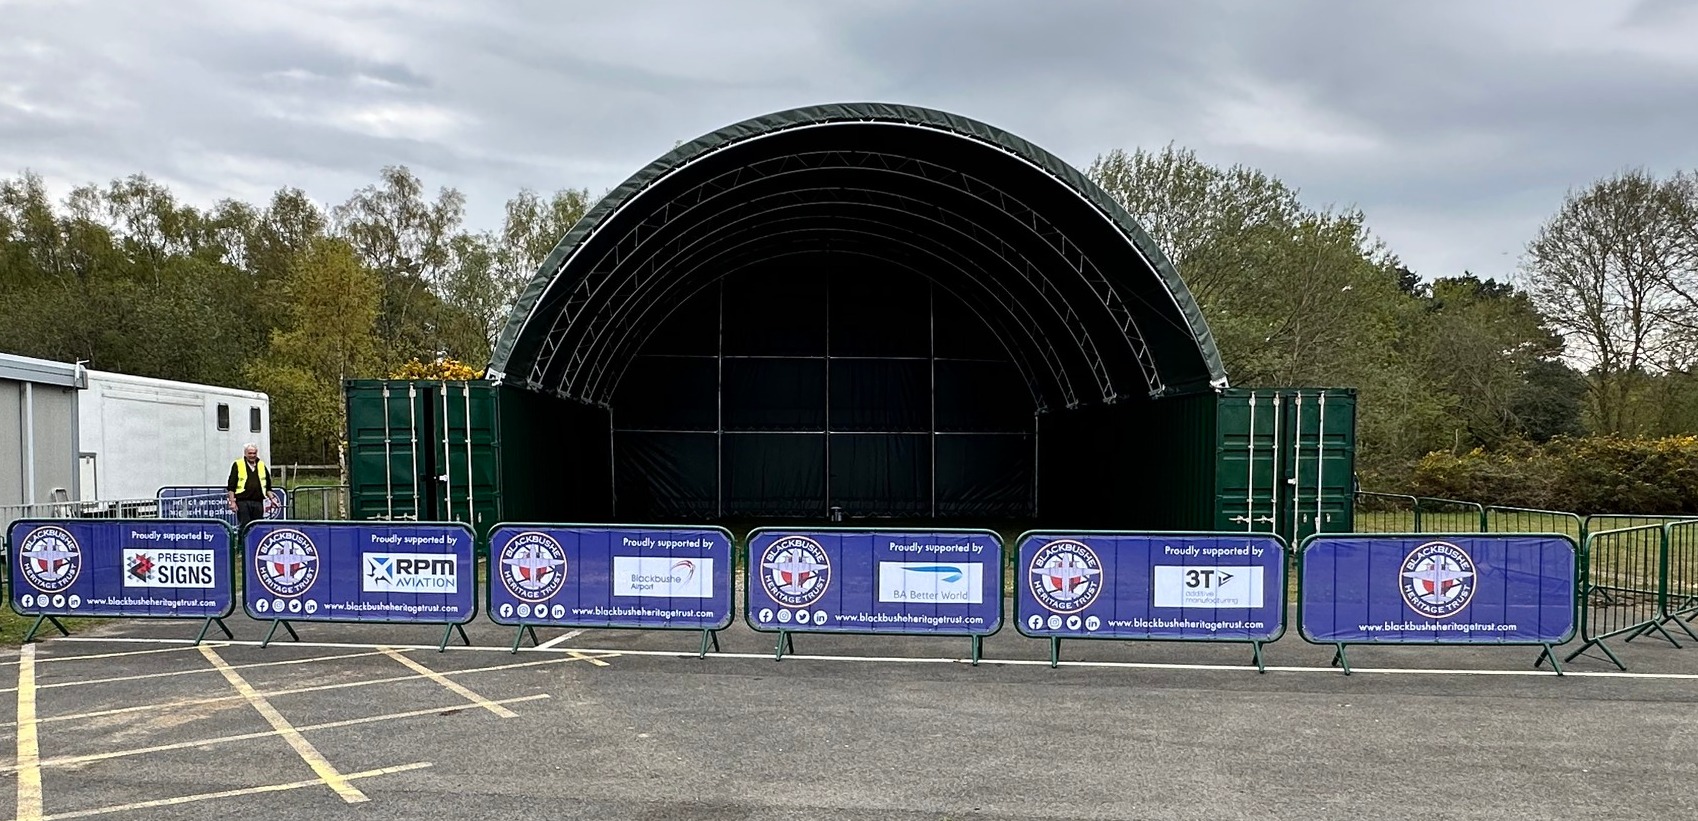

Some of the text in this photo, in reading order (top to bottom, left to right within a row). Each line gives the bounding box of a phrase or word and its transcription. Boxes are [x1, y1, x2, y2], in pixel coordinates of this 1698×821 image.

[25, 528, 76, 551] BLACKBUSHE
[132, 531, 214, 542] Proudly supported by
[371, 534, 457, 546] Proudly supported by
[261, 532, 313, 555] BLACKBUSHE
[506, 535, 560, 558] BLACKBUSHE
[623, 537, 714, 550] Proudly supported by
[890, 543, 984, 555] Proudly supported by
[767, 539, 825, 563] BLACKBUSHE
[1036, 544, 1096, 567] BLACKBUSHE
[1165, 545, 1264, 558] Proudly supported by
[158, 553, 211, 563] PRESTIGE
[1406, 545, 1470, 571] BLACKBUSHE
[24, 563, 77, 589] HERITAGE TRUST
[158, 565, 212, 584] SIGNS
[260, 567, 315, 594] HERITAGE TRUST
[631, 574, 682, 584] Blackbushe
[1185, 570, 1214, 588] 3T
[396, 578, 455, 587] AVIATION
[504, 570, 563, 598] HERITAGE TRUST
[631, 584, 654, 592] Airport
[765, 575, 826, 603] HERITAGE TRUST
[893, 591, 968, 600] BA Better World
[1034, 581, 1098, 609] HERITAGE TRUST
[1404, 584, 1471, 614] HERITAGE TRUST
[87, 597, 216, 608] www.blackbusheheritagetrust.com
[324, 601, 458, 614] www.blackbusheheritagetrust.com
[572, 606, 714, 619] www.blackbusheheritagetrust.com
[835, 613, 984, 626] www.blackbusheheritagetrust.com
[1108, 618, 1264, 632] www.blackbusheheritagetrust.com
[1358, 622, 1517, 634] www.blackbusheheritagetrust.com
